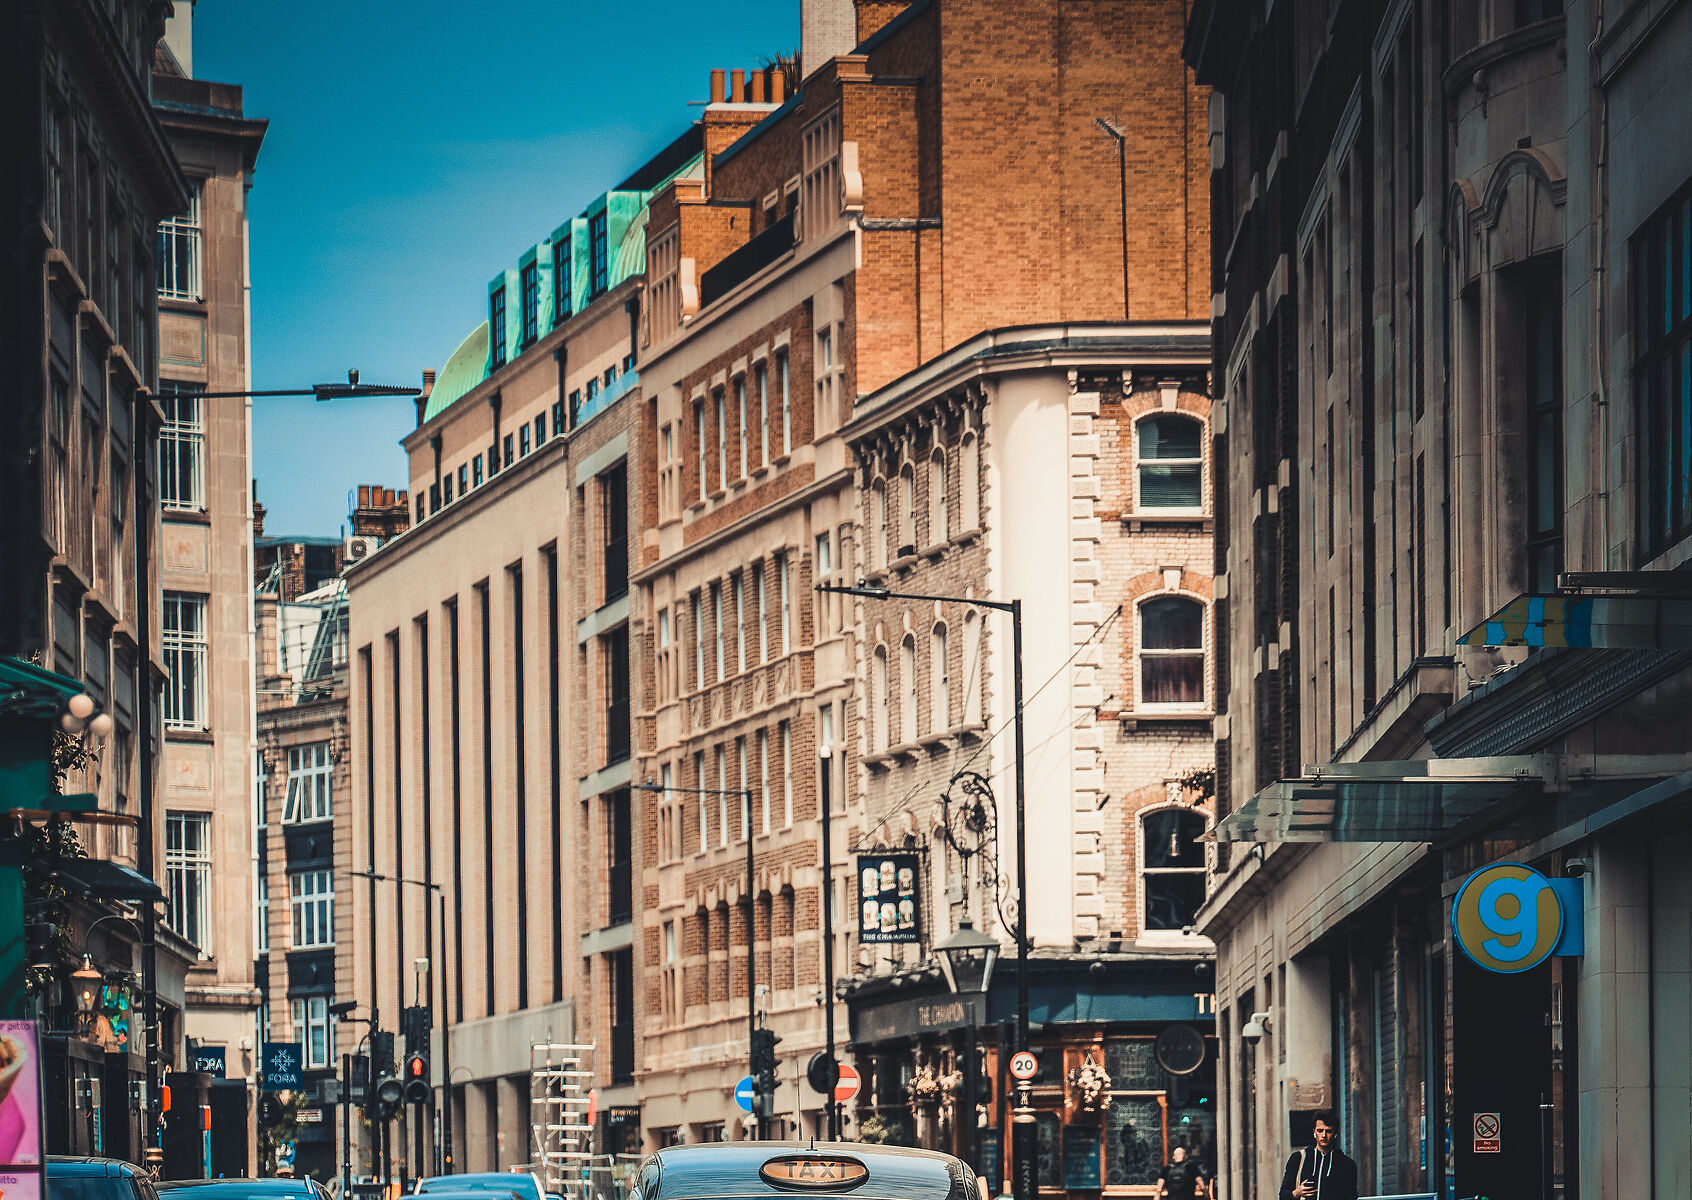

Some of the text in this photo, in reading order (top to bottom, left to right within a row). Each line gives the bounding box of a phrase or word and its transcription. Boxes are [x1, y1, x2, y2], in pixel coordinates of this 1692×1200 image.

[1015, 1060, 1033, 1071] 20
[267, 1073, 297, 1084] FORA
[783, 1161, 846, 1179] TAXI
